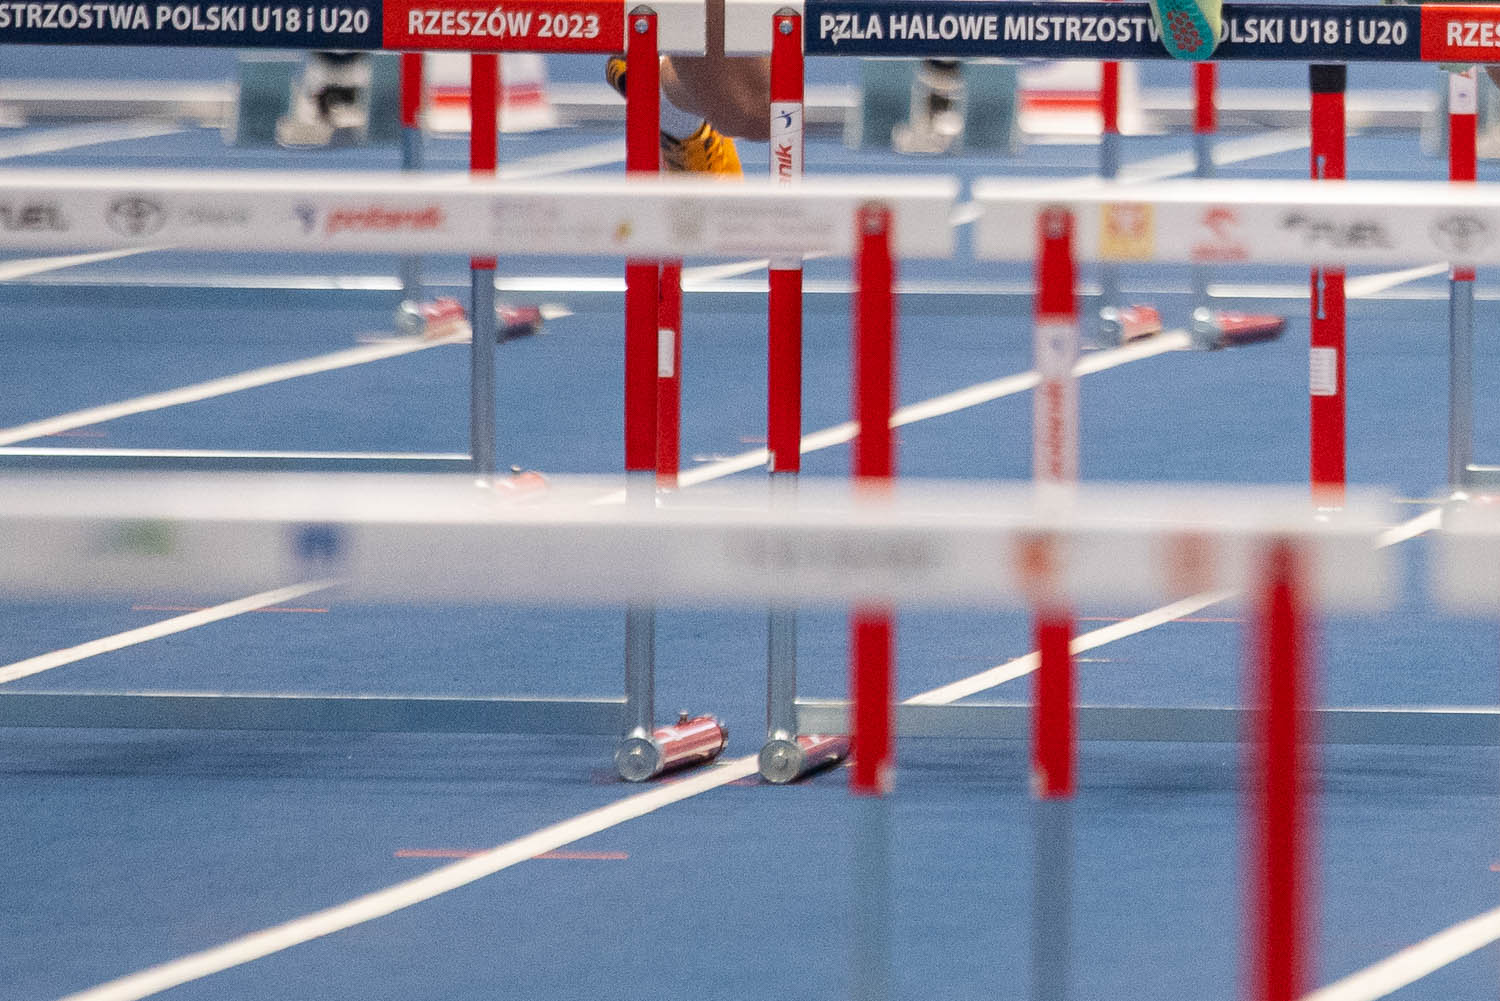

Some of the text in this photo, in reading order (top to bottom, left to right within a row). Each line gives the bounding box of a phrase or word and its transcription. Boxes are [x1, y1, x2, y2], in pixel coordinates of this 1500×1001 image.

[156, 6, 245, 31] POLSKI
[252, 7, 300, 32] U18
[306, 9, 314, 33] i
[319, 9, 370, 34] U20
[408, 8, 531, 38] RZESZÓW
[537, 14, 600, 39] 2023
[819, 14, 883, 42] PZLA
[889, 15, 998, 41] HALOWE
[1004, 16, 1160, 43] MISTRZOST
[1290, 19, 1340, 45] U18
[1344, 19, 1351, 45] i
[1358, 21, 1407, 46] U20
